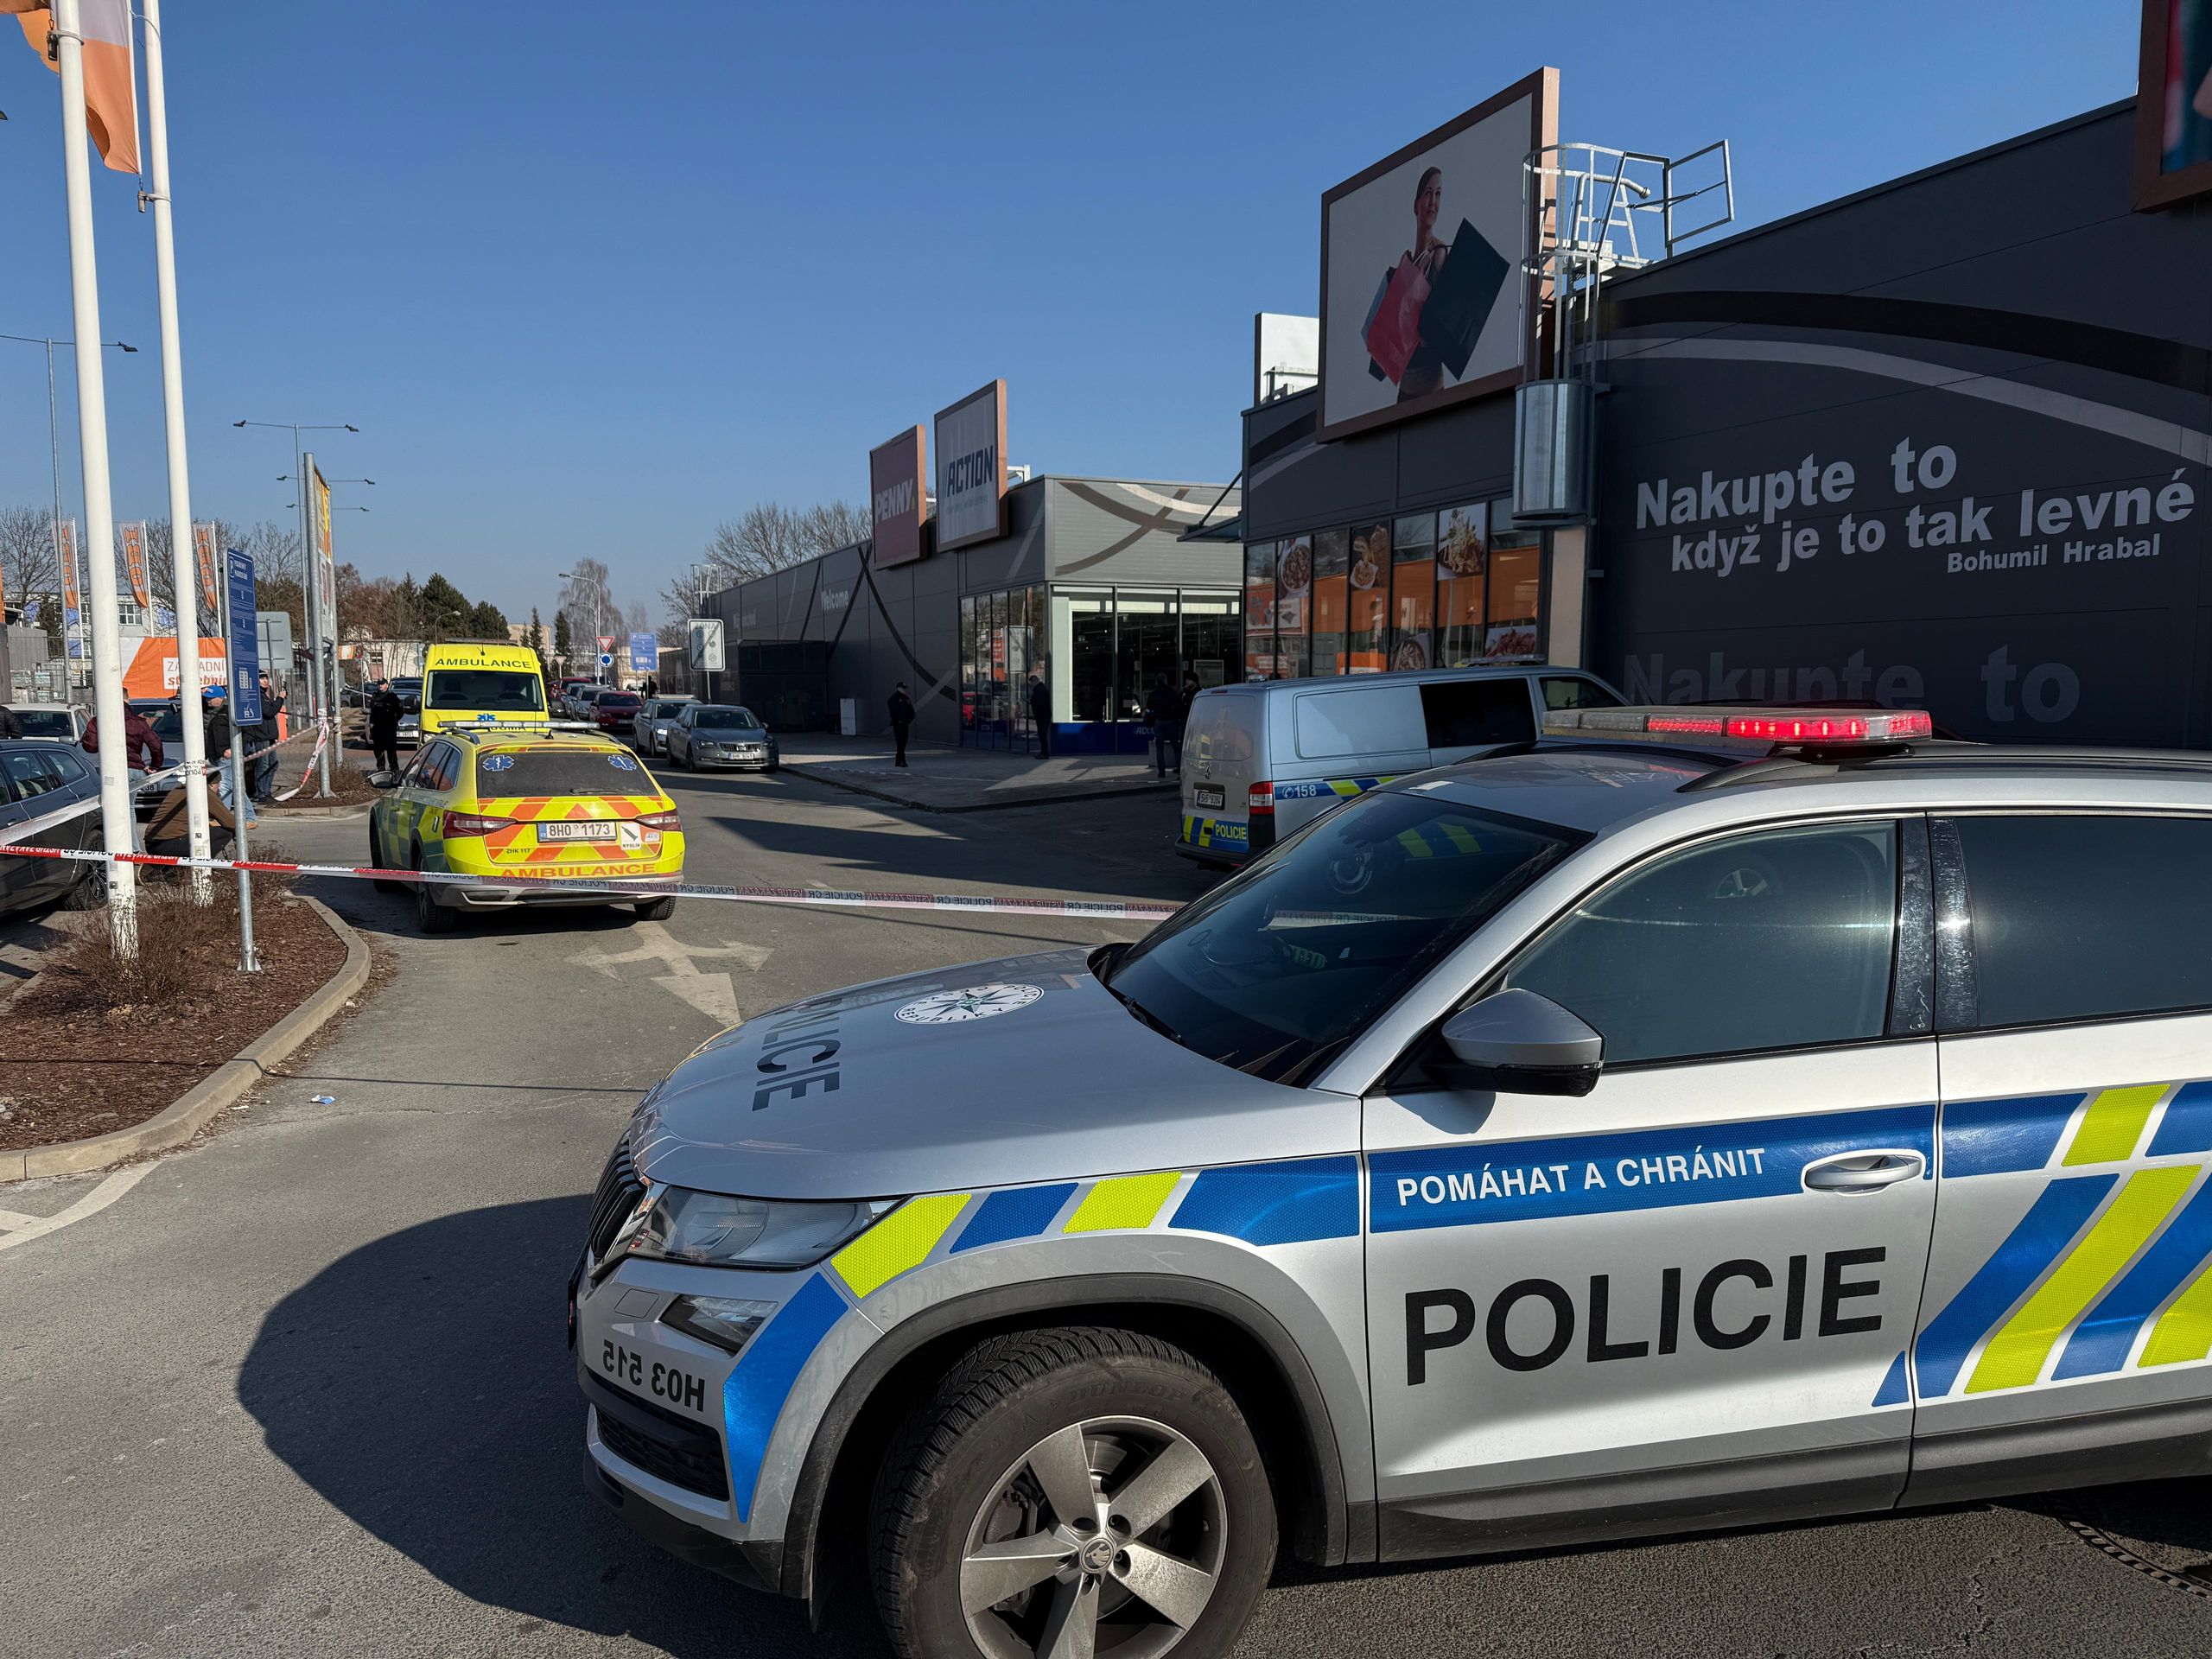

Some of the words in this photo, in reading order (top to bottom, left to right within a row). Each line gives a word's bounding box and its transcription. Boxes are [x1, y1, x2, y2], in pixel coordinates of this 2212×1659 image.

[947, 445, 994, 499] ACTION
[1637, 453, 1855, 530] Nakupte
[1891, 436, 1957, 493] to
[1671, 524, 1761, 578] když
[1776, 520, 1820, 572] je
[1838, 513, 1886, 555] to
[1905, 497, 1994, 549] tak
[2019, 467, 2195, 537] levné
[1947, 544, 2048, 574] Bohumil
[2063, 532, 2161, 563] Hrabal
[822, 589, 849, 611] Welcome
[168, 660, 225, 672] ZADNÍ
[435, 658, 532, 669] AMBULANCE
[1981, 644, 2081, 724] to
[1294, 785, 1317, 798] 158
[582, 823, 610, 836] 1173
[1216, 824, 1247, 840] POLICIE
[502, 864, 656, 877] AMBULANCE
[1397, 1164, 1569, 1206] POMÁHAT
[1584, 1163, 1607, 1190] A
[1616, 1145, 1766, 1186] CHRÁNIT
[1405, 1245, 1887, 1387] POLICIE
[1069, 1380, 1183, 1406] DUNLOP
